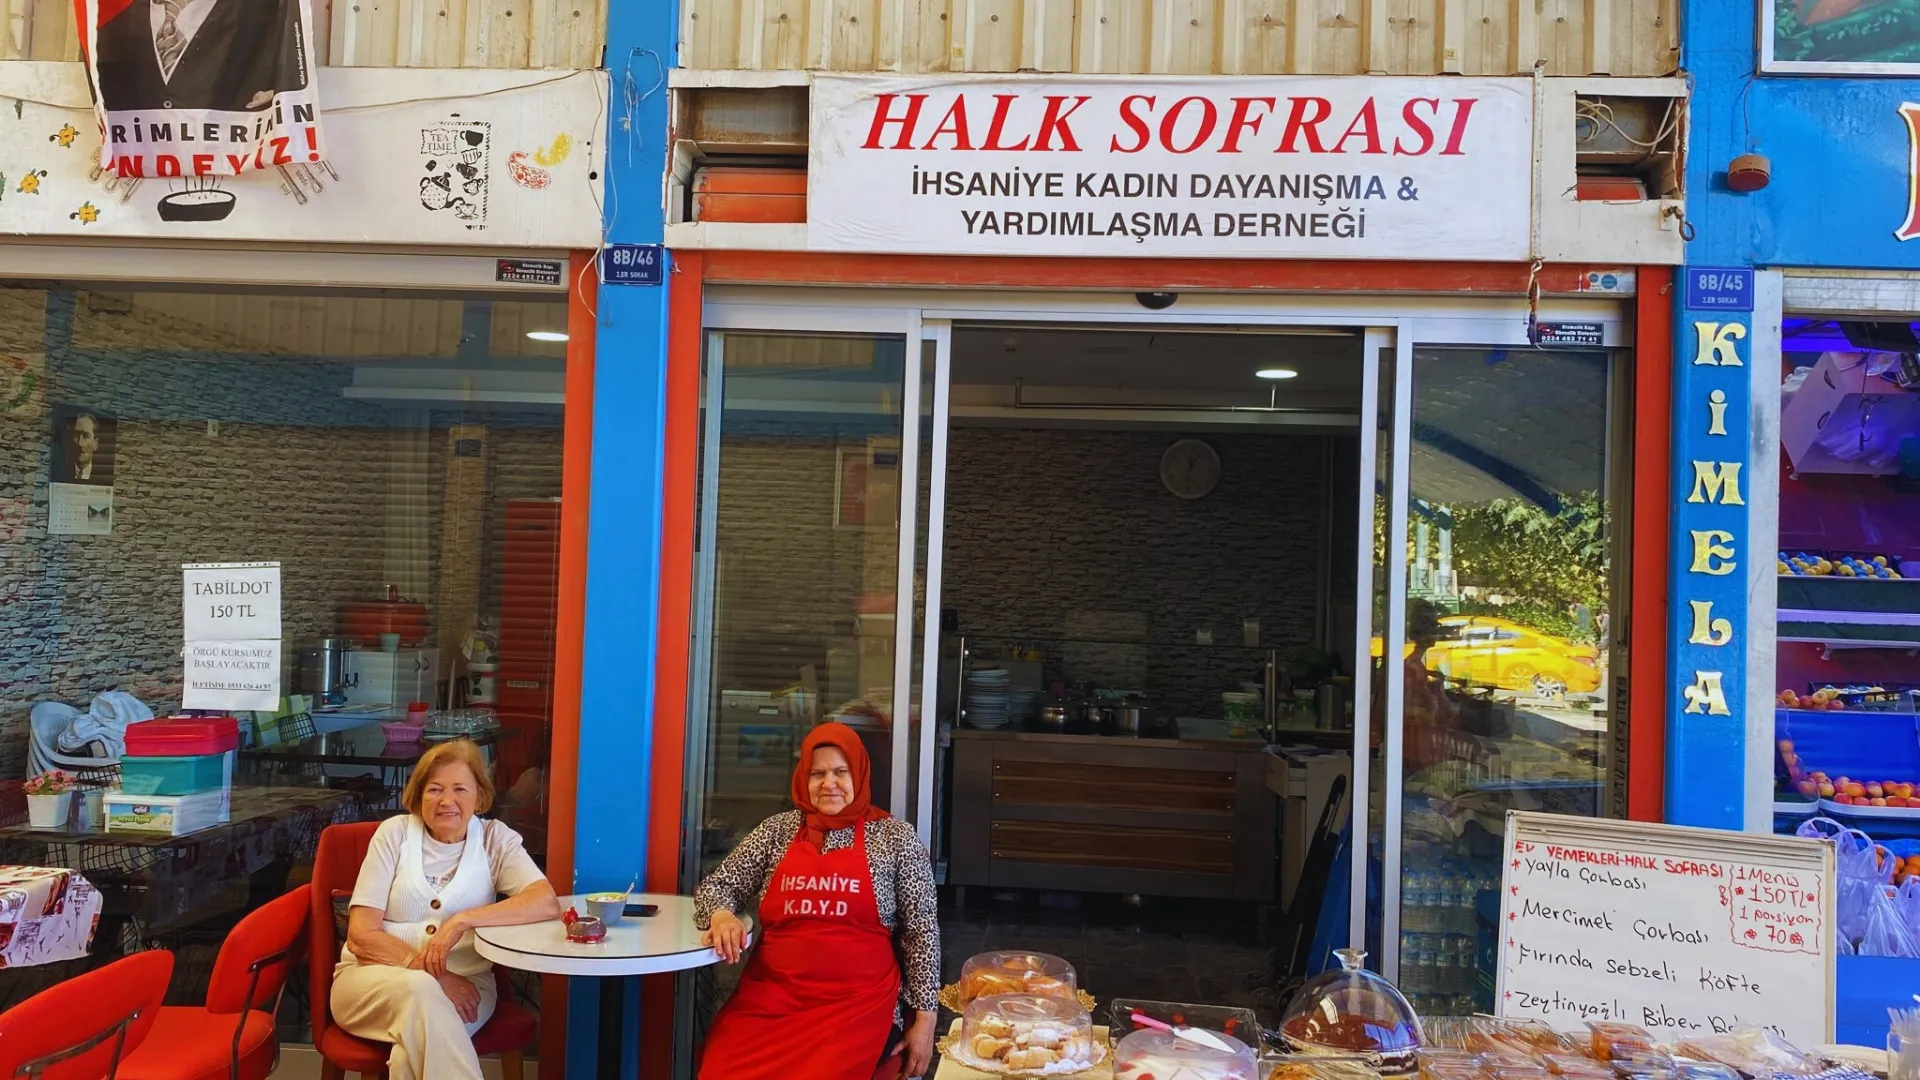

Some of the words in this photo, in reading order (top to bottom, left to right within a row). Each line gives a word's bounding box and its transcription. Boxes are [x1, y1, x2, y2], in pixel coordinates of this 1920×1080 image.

[861, 93, 1093, 152] HALK
[1109, 94, 1479, 157] SOFRASI
[430, 133, 449, 142] TEA
[106, 127, 320, 177] NDEYİZ!
[427, 143, 452, 151] TIME
[912, 164, 1064, 198] İHSANİYE
[1076, 172, 1178, 199] KADIN
[1189, 173, 1386, 206] DAYANIŞMA
[1396, 175, 1419, 201] &
[961, 209, 1203, 244] YARDIMLAŞMA
[1213, 205, 1366, 238] DERNEĞİ
[613, 249, 654, 266] 8B/46
[1698, 275, 1743, 292] 8B/45
[1685, 322, 1747, 716] KİMELA
[193, 580, 272, 595] TABİLDOT
[210, 605, 233, 618] 150
[237, 605, 256, 617] TL
[193, 647, 219, 657] ÖRGÜ
[221, 649, 272, 658] KURSUMUZ
[1515, 841, 1535, 853] EV
[780, 873, 861, 893] İHSANİYE
[783, 900, 848, 916] K.D.Y.D
[1765, 925, 1787, 944] 70
[1643, 1003, 1702, 1031] Biber
